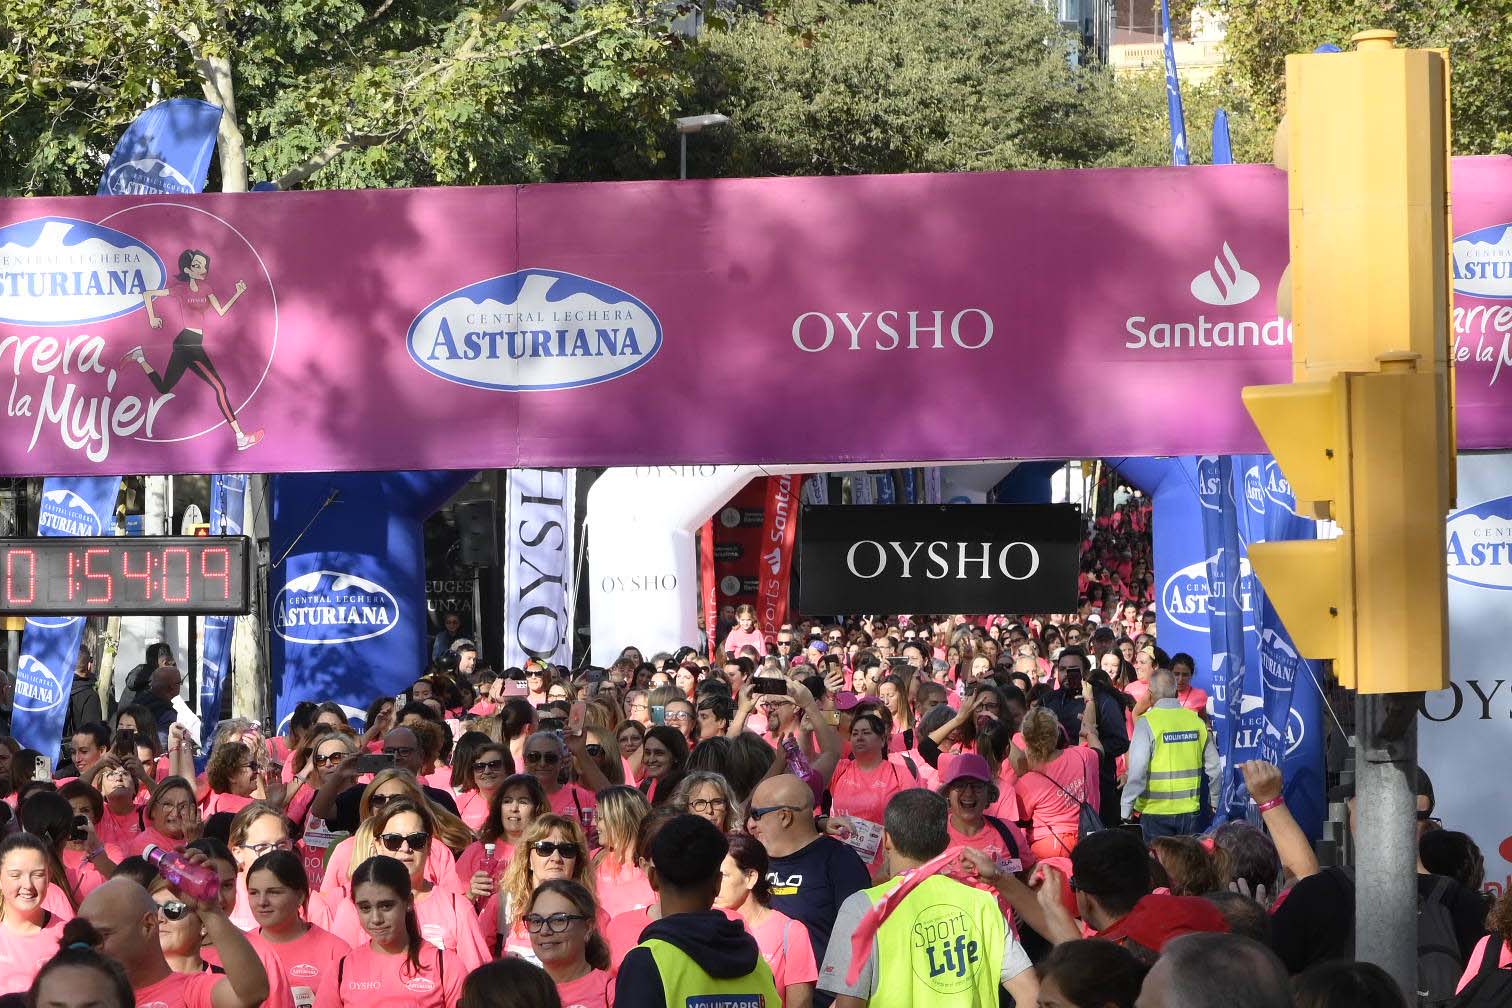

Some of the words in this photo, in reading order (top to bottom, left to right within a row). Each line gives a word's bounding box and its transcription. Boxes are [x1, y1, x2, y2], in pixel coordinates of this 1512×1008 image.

[69, 251, 142, 265] LECHERA
[465, 310, 544, 326] CENTRAL
[551, 308, 634, 323] LECHERA
[791, 307, 995, 353] OYSHO
[1453, 304, 1512, 334] arre
[427, 316, 643, 361] ASTURIANA
[1476, 333, 1494, 362] la
[7, 378, 33, 418] la
[26, 368, 176, 463] Mujer
[845, 539, 1041, 581] OYSHO
[6, 547, 230, 604] 01:54:09
[601, 572, 678, 593] OYSHO
[277, 600, 390, 628] ASTURIANA
[289, 595, 333, 605] CENTRAL
[336, 594, 386, 605] LECHERA
[914, 911, 968, 948] Sport
[925, 934, 979, 978] Life
[348, 981, 382, 990] OYSHO
